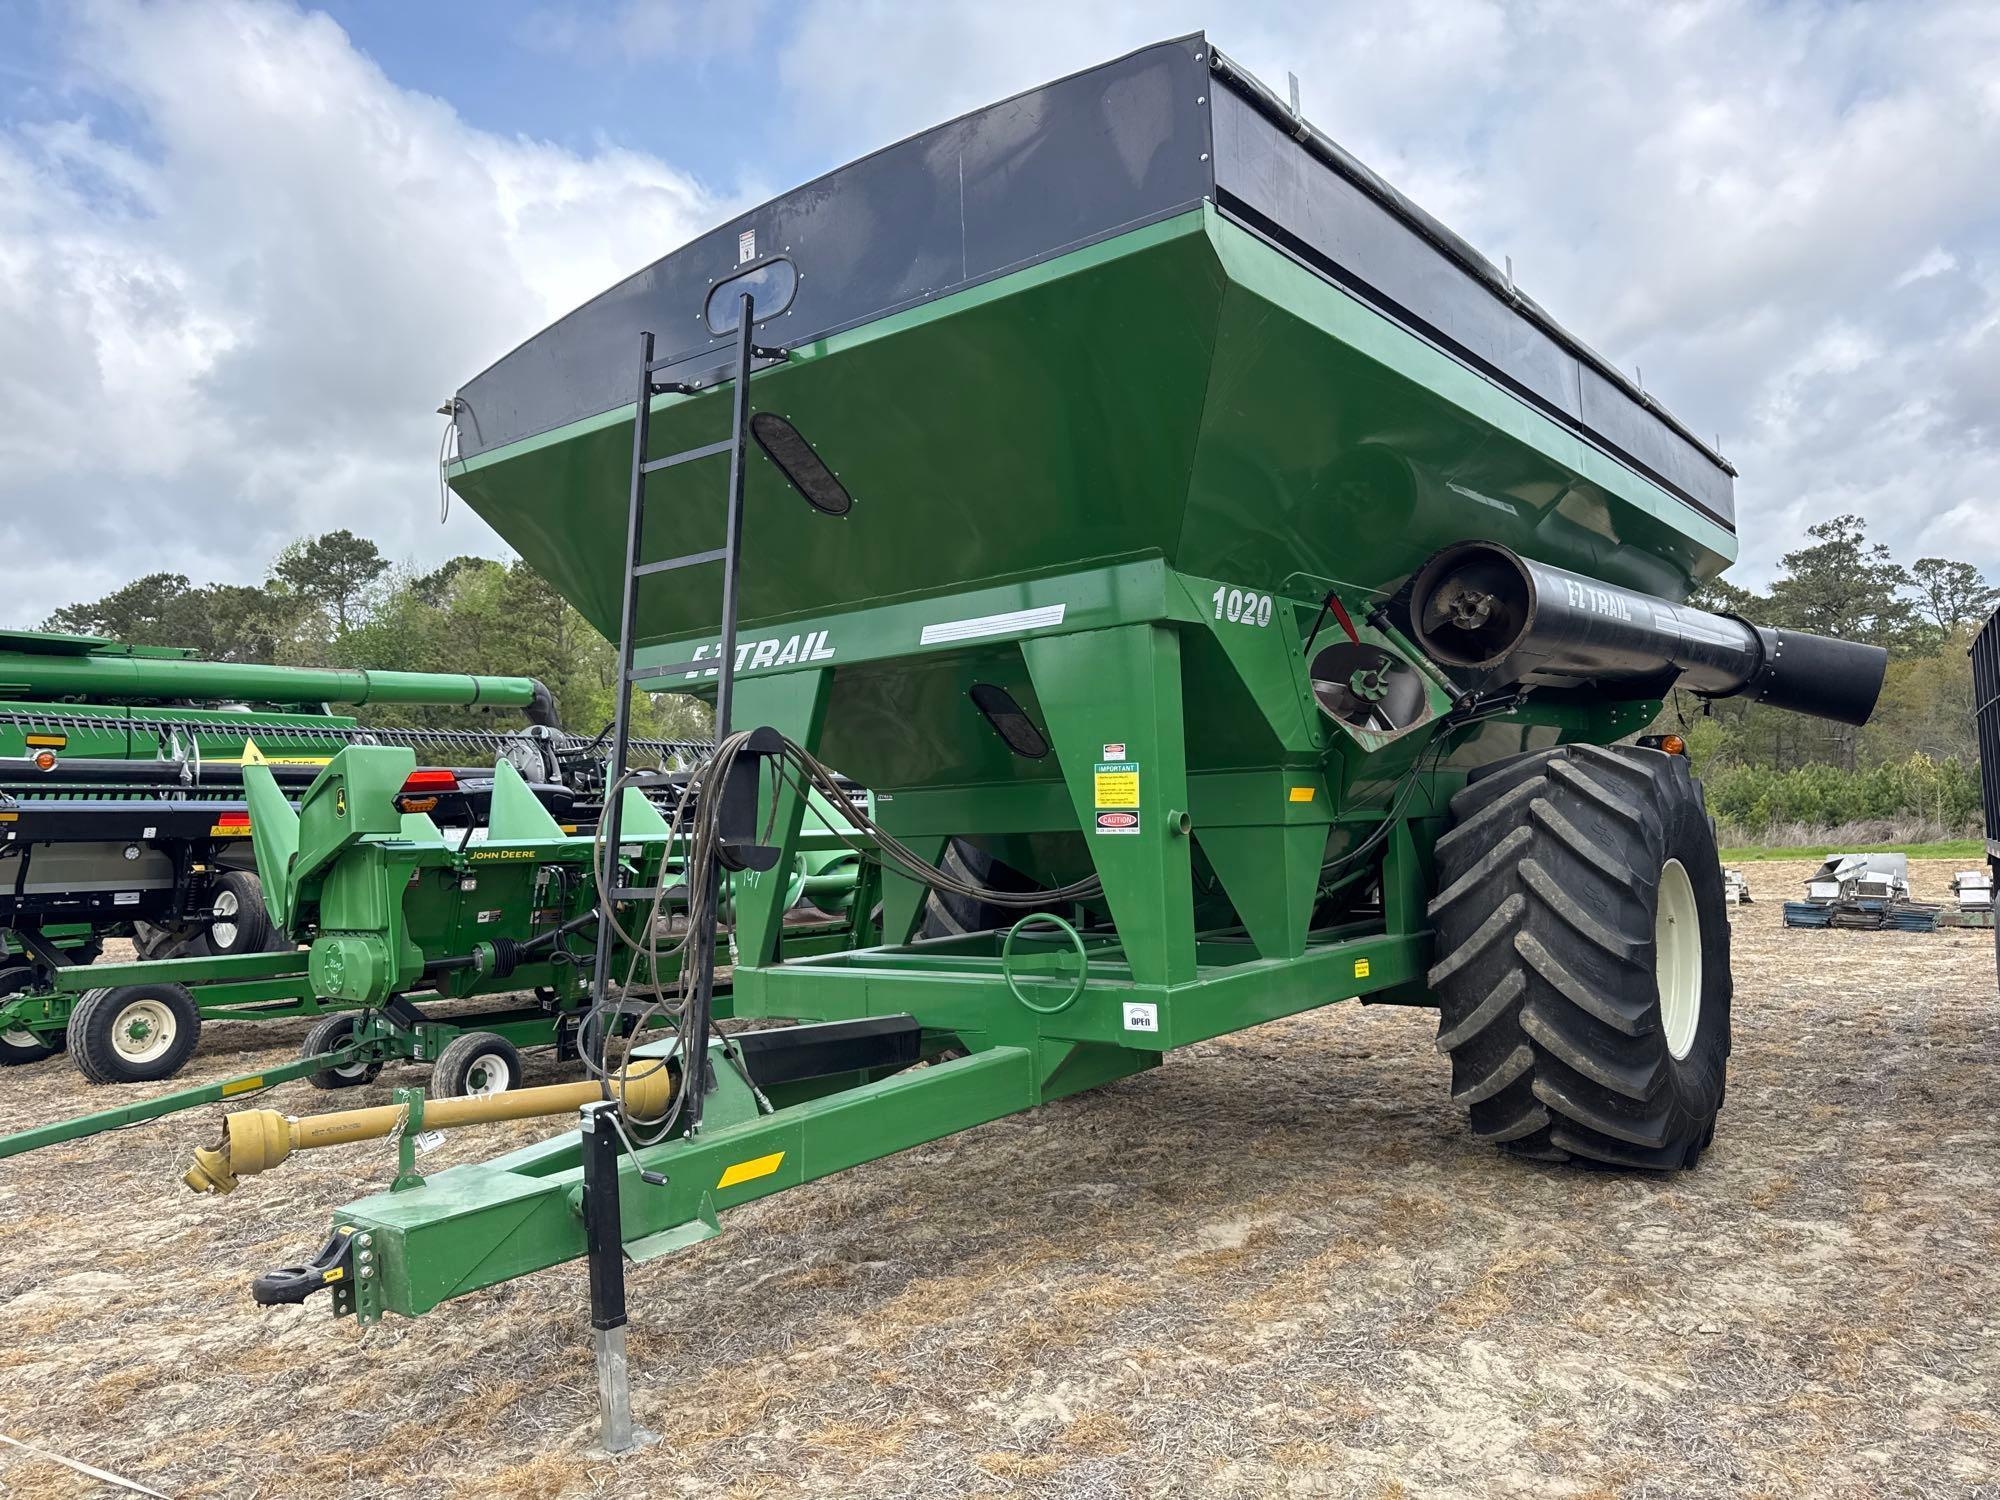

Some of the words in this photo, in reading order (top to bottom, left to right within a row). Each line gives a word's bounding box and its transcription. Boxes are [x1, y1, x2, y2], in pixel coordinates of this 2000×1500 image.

[1212, 586, 1272, 628] 1020
[1586, 588, 1632, 621] TRAIL
[734, 630, 836, 672] TRAIL
[1098, 764, 1135, 772] IMPORTANT
[1102, 816, 1132, 824] CAUTION
[470, 851, 499, 860] JOHN
[501, 850, 536, 859] DEERE
[1131, 1017, 1151, 1027] OPEN
